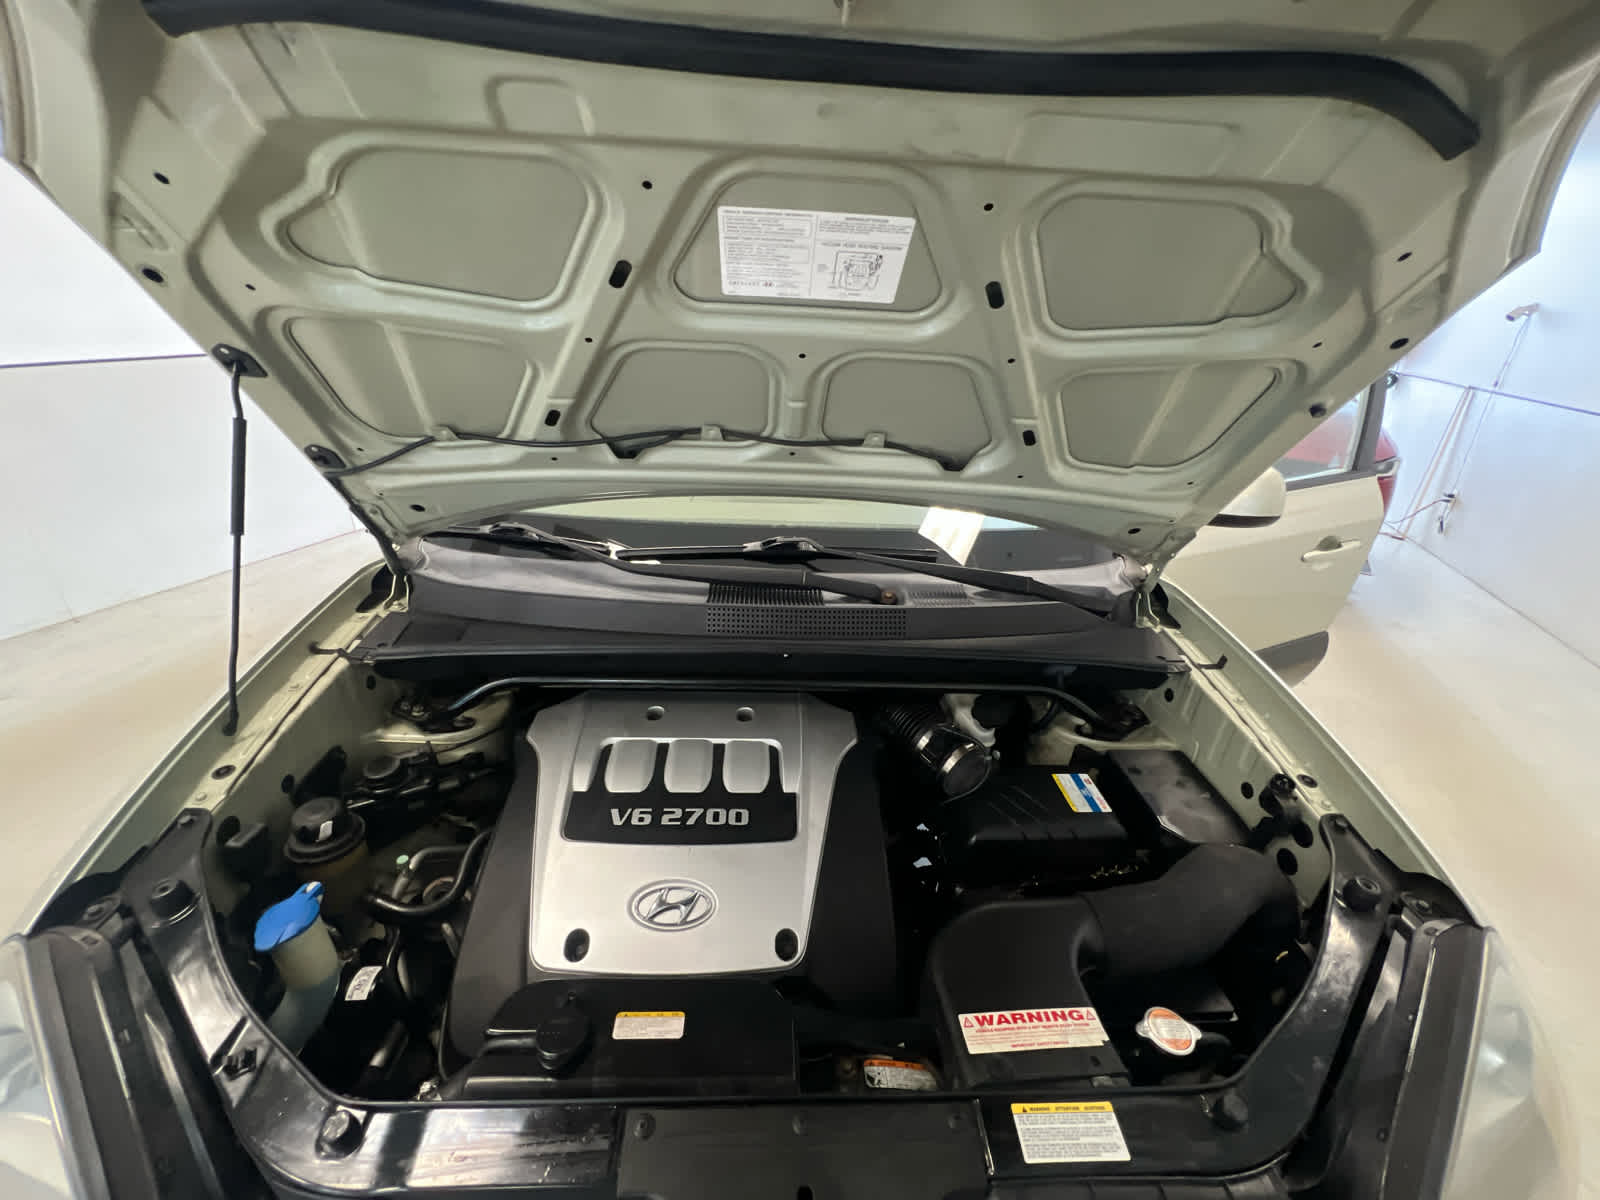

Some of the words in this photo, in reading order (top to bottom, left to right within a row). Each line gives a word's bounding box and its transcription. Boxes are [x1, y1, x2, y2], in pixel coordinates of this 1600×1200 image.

[610, 808, 652, 826] V6
[660, 808, 750, 826] 2700
[974, 1009, 1084, 1027] WARNING
